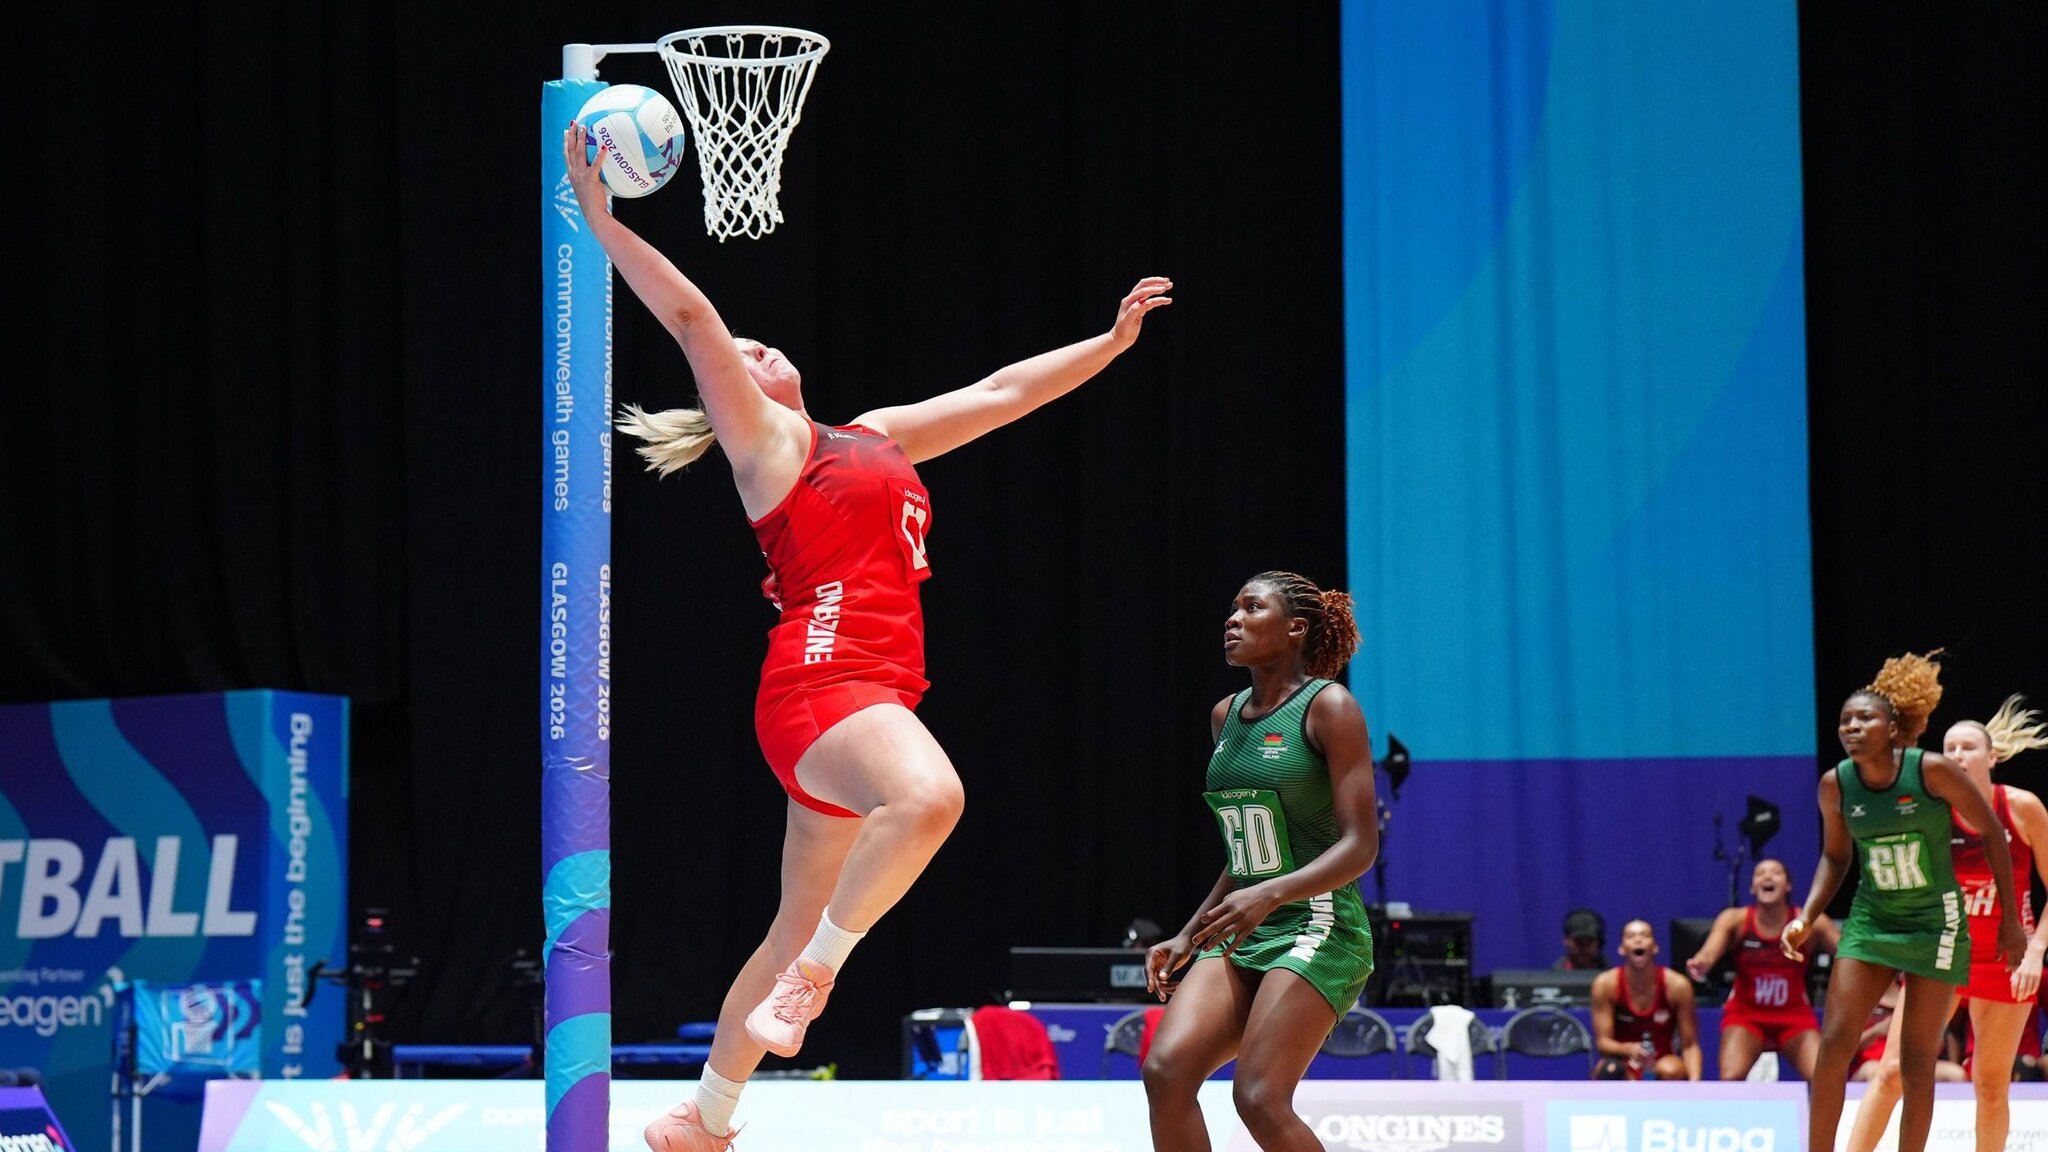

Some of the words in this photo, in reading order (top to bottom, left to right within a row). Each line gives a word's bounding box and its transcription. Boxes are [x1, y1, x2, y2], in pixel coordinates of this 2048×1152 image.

[598, 126, 617, 152] 2026
[612, 152, 650, 189] GLASGOW
[556, 243, 574, 424] commonwealth
[603, 252, 613, 425] ommonwealth
[552, 429, 570, 511] games
[600, 432, 612, 514] games
[551, 562, 568, 678] GLASGOW
[598, 564, 611, 679] GLASGOW
[550, 684, 565, 741] 2026
[598, 684, 611, 741] 2026
[285, 712, 314, 883] beginning
[1217, 805, 1283, 875] GD
[1868, 841, 1928, 891] GK
[283, 888, 307, 945] the
[282, 953, 308, 1019] just
[1755, 976, 1788, 1006] WD
[282, 1022, 304, 1054] is
[1302, 1114, 1505, 1143] ONGINES
